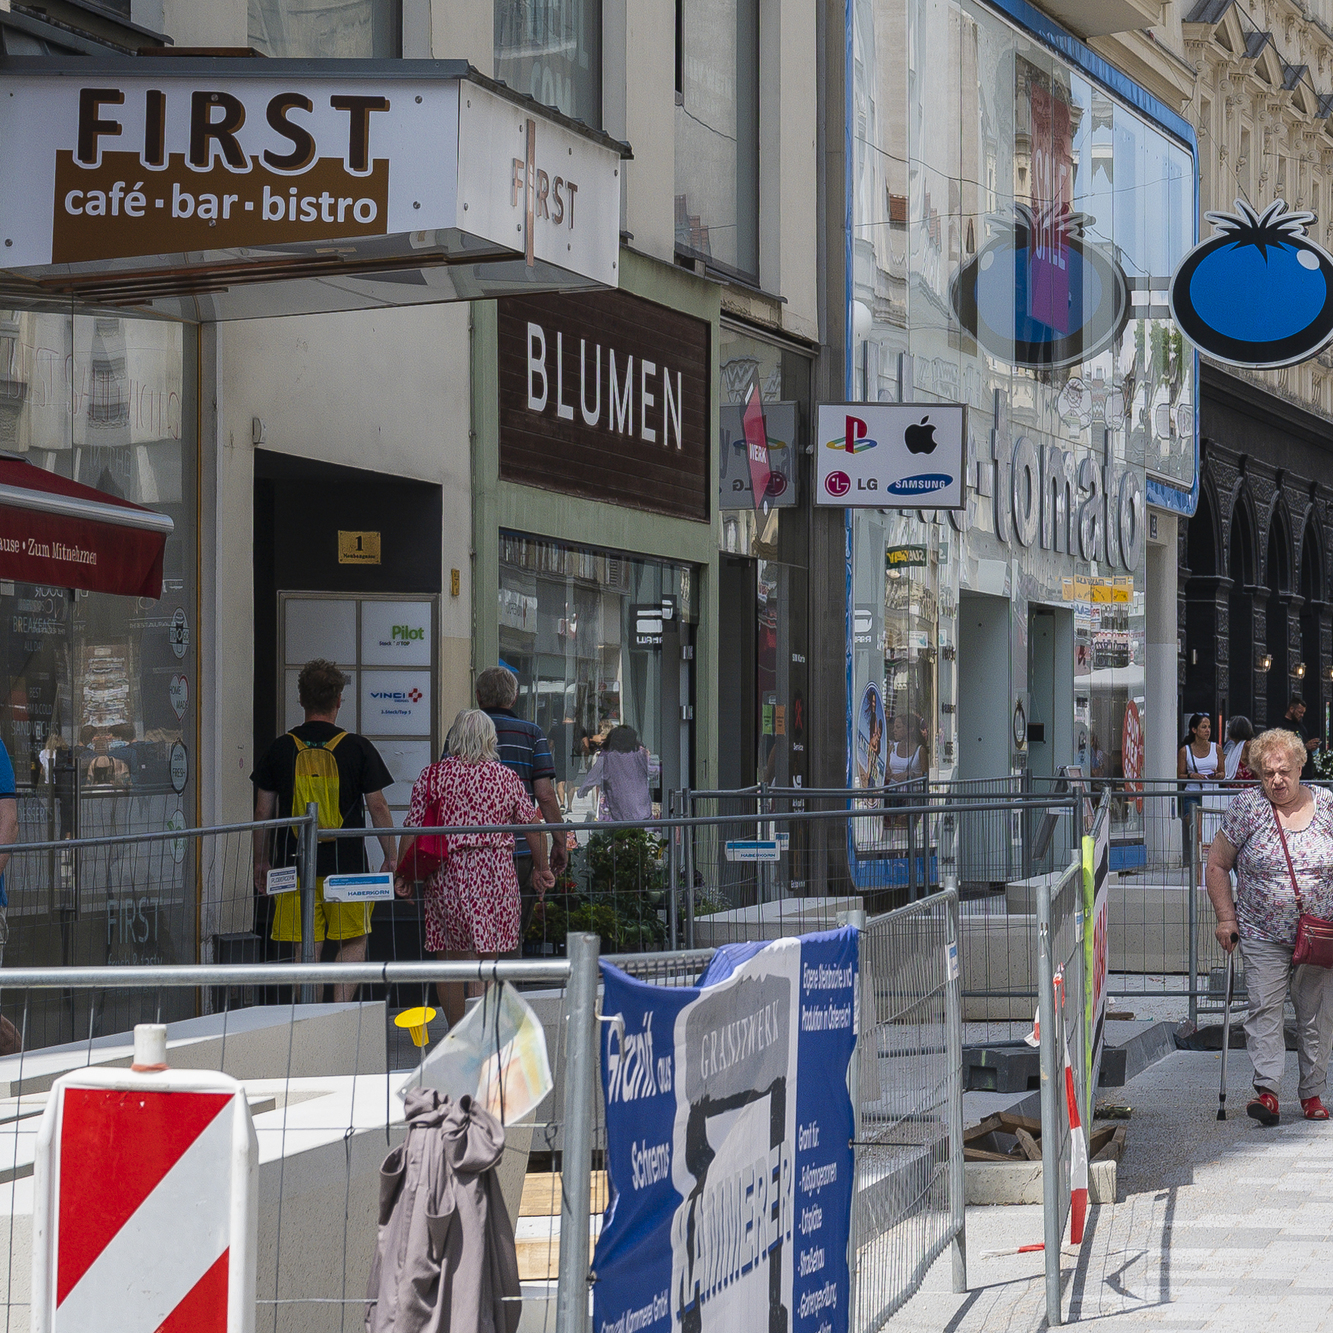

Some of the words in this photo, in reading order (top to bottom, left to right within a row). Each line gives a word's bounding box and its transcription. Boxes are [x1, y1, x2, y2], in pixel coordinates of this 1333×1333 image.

[74, 86, 391, 175] FIRST
[64, 181, 147, 217] café
[170, 183, 239, 221] bar
[261, 185, 379, 224] bistro
[527, 321, 682, 450] BLUMEN
[857, 478, 878, 491] LG
[895, 478, 946, 490] SAMSUNG
[27, 537, 50, 557] Zum
[355, 535, 363, 551] 1
[391, 625, 425, 640] Pilot
[347, 889, 390, 897] HABERKORN
[700, 998, 780, 1079] GRANITWERK
[631, 1137, 672, 1192] Schrems
